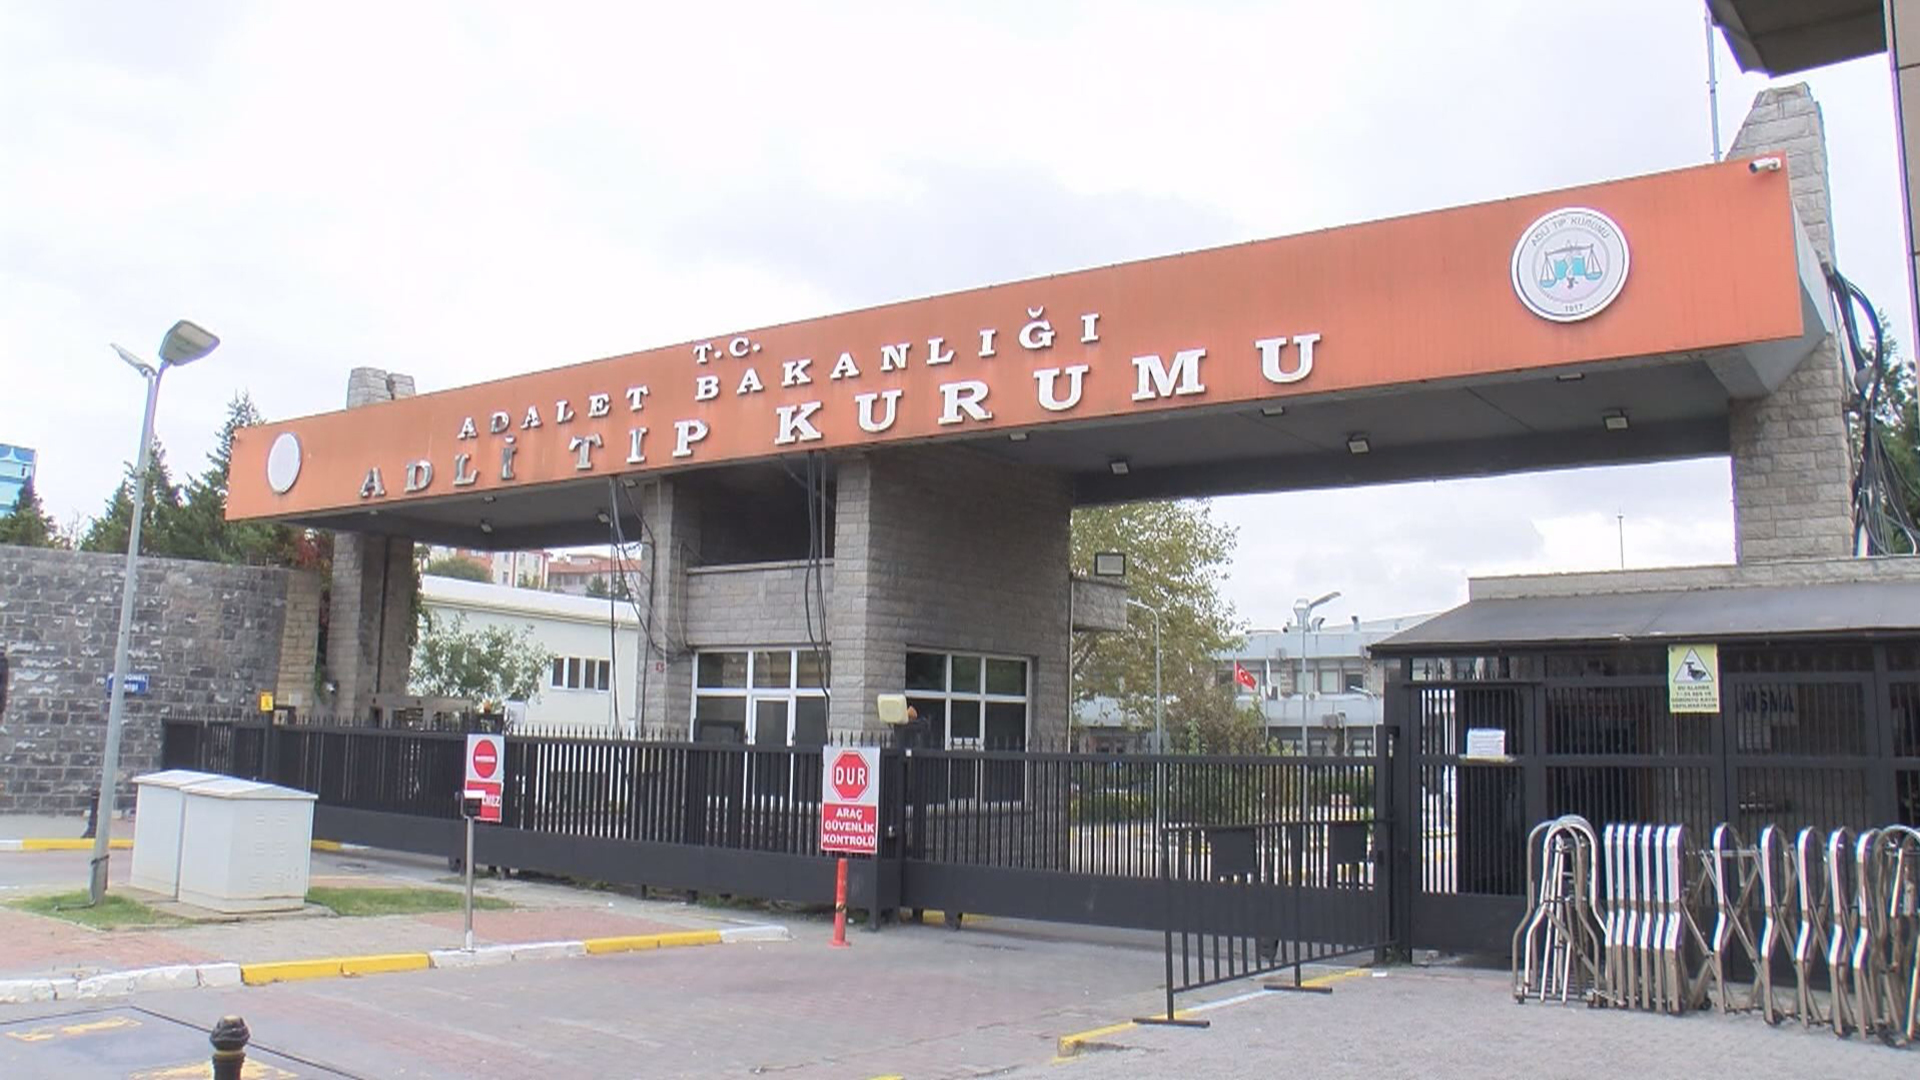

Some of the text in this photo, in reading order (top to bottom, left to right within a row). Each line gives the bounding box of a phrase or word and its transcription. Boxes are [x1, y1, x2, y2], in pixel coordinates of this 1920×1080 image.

[692, 336, 762, 365] T.C.
[456, 303, 1102, 440] ADALET BAKANLIĞI
[358, 331, 1323, 499] ADLİ TIP KURUMU
[835, 766, 866, 786] DUR
[836, 807, 863, 820] ARAÇ
[824, 819, 875, 833] GÜVENLİK
[823, 833, 875, 848] KONTROLÜ
